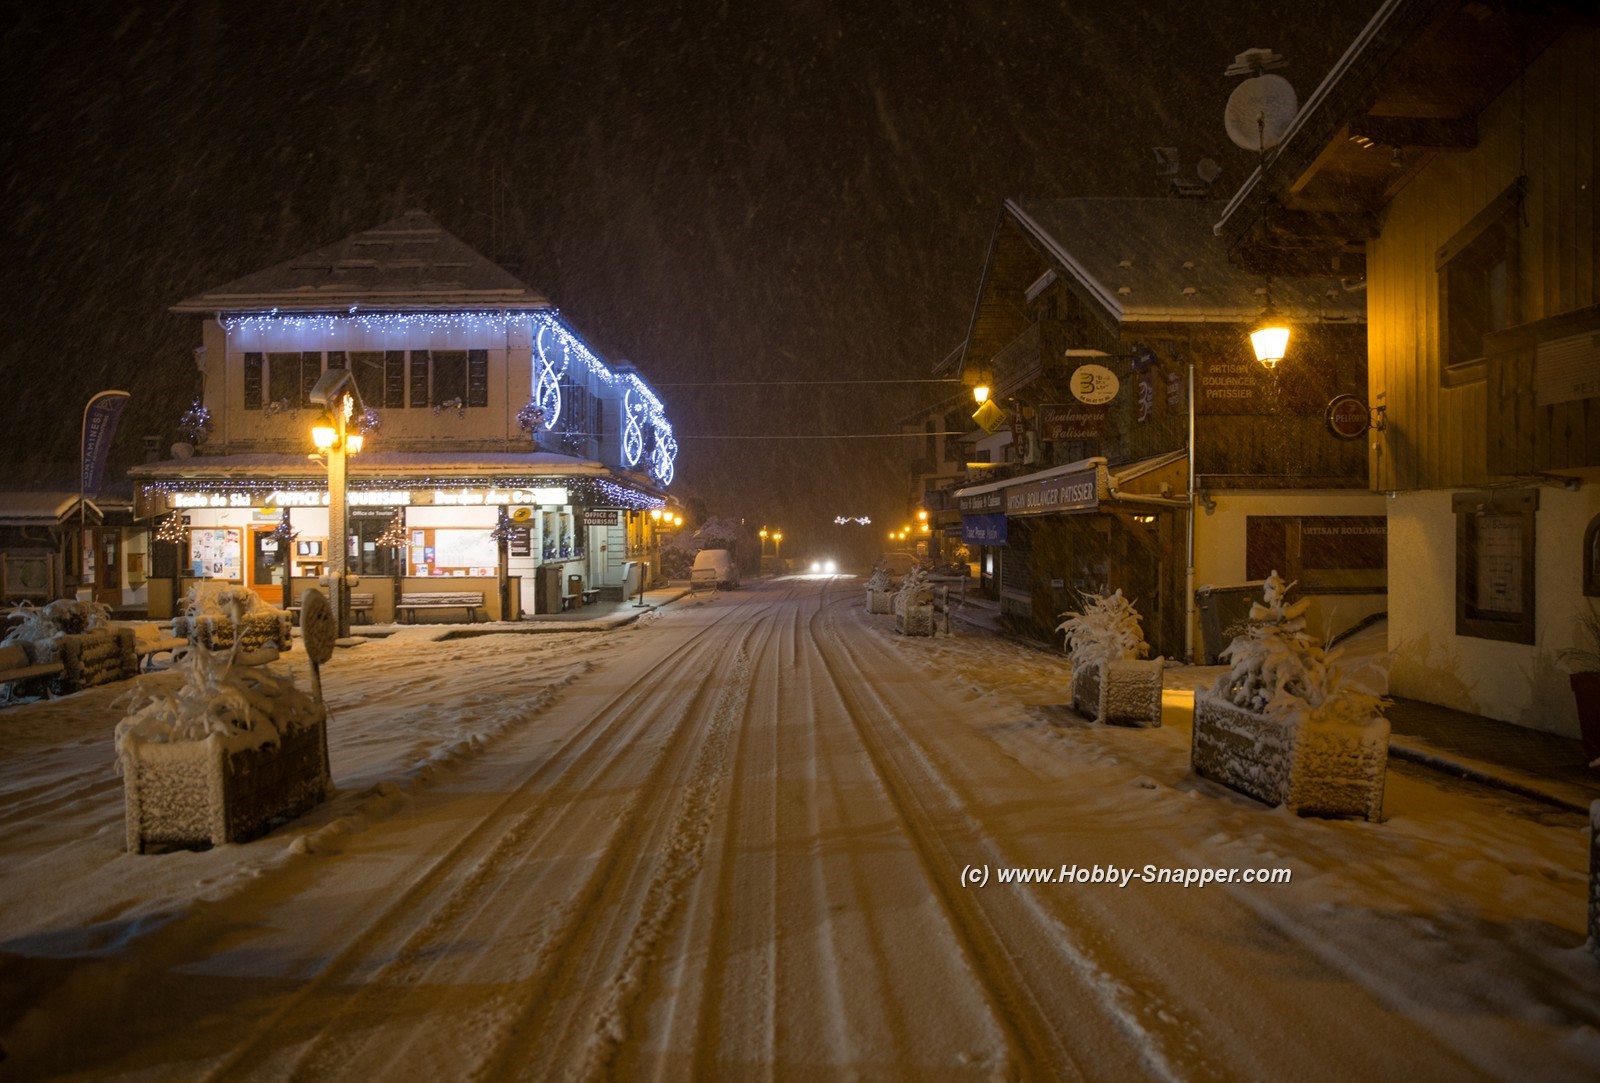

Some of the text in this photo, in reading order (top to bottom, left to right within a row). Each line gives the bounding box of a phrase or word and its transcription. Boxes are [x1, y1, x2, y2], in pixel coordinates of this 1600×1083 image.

[1209, 364, 1249, 374] ARTISAN
[1202, 376, 1256, 386] BOULANGER
[1206, 389, 1253, 399] PATISSIER
[1044, 408, 1105, 426] Boulangerie
[1014, 402, 1025, 456] TABAC
[230, 493, 251, 506] Ski
[276, 492, 320, 505] OFFICE
[1027, 488, 1059, 508] BOULANGER
[1060, 482, 1095, 504] PATISSIER
[584, 511, 617, 519] OFFICE de
[1340, 526, 1387, 535] BOULANGE
